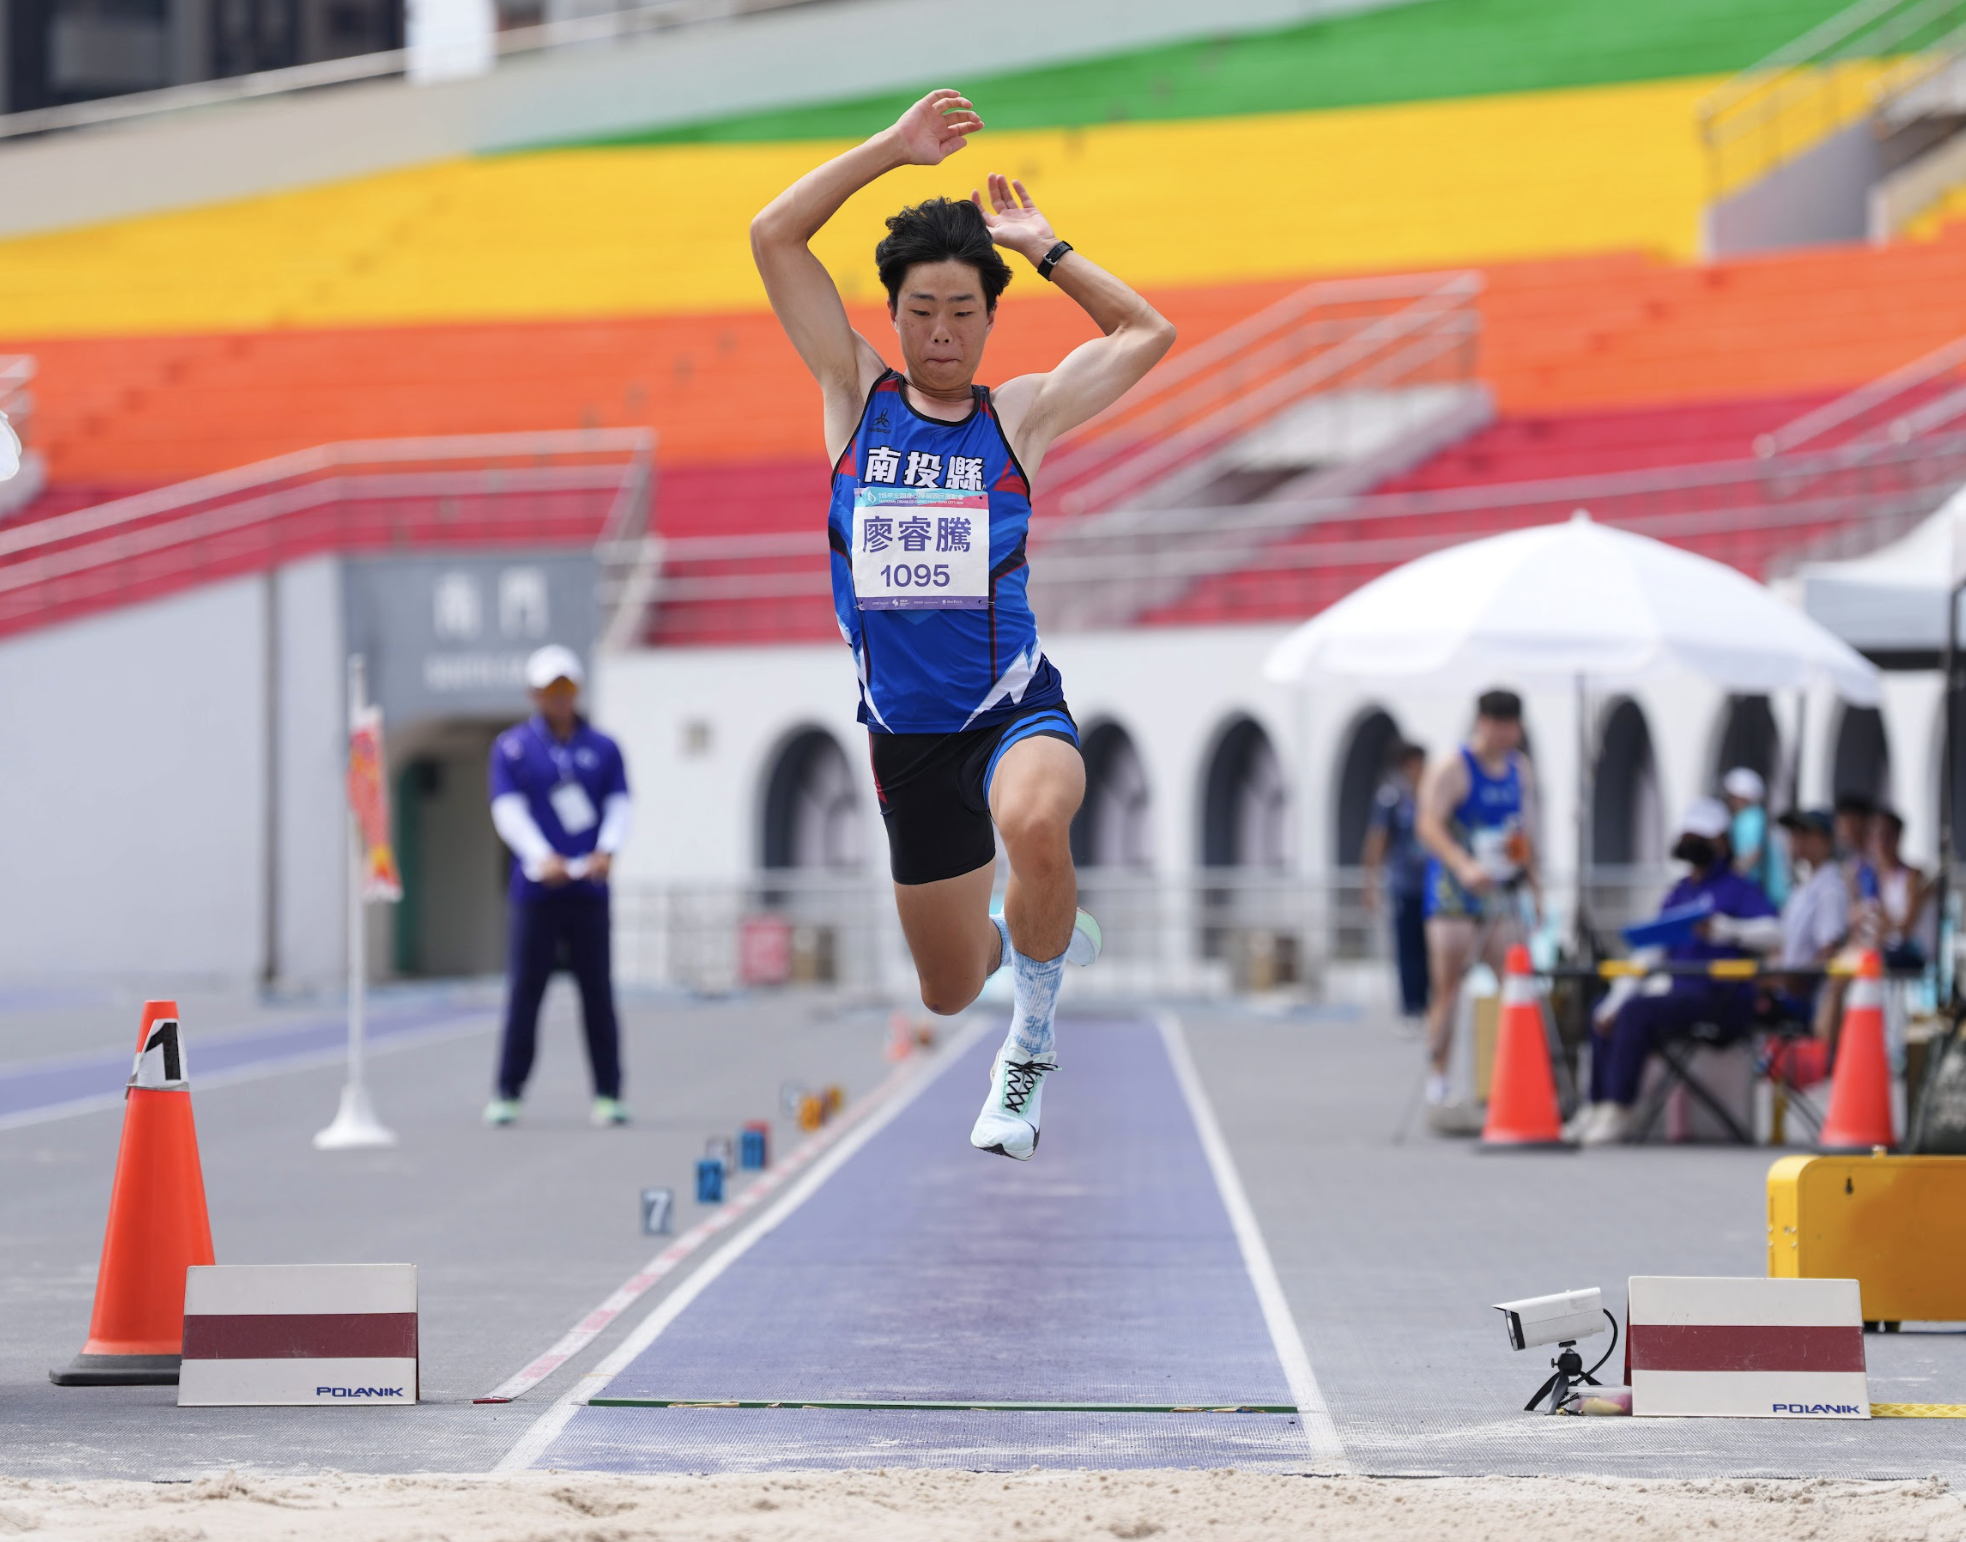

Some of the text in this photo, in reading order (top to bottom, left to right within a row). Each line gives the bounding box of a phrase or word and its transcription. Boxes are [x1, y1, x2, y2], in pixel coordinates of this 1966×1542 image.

[864, 446, 984, 490] 南投縣
[862, 515, 972, 553] 廖睿騰
[880, 563, 950, 588] 1095
[145, 1022, 181, 1080] 1
[644, 1190, 669, 1231] 7
[316, 1387, 403, 1397] POLANIK
[1773, 1404, 1860, 1414] POLANIK
